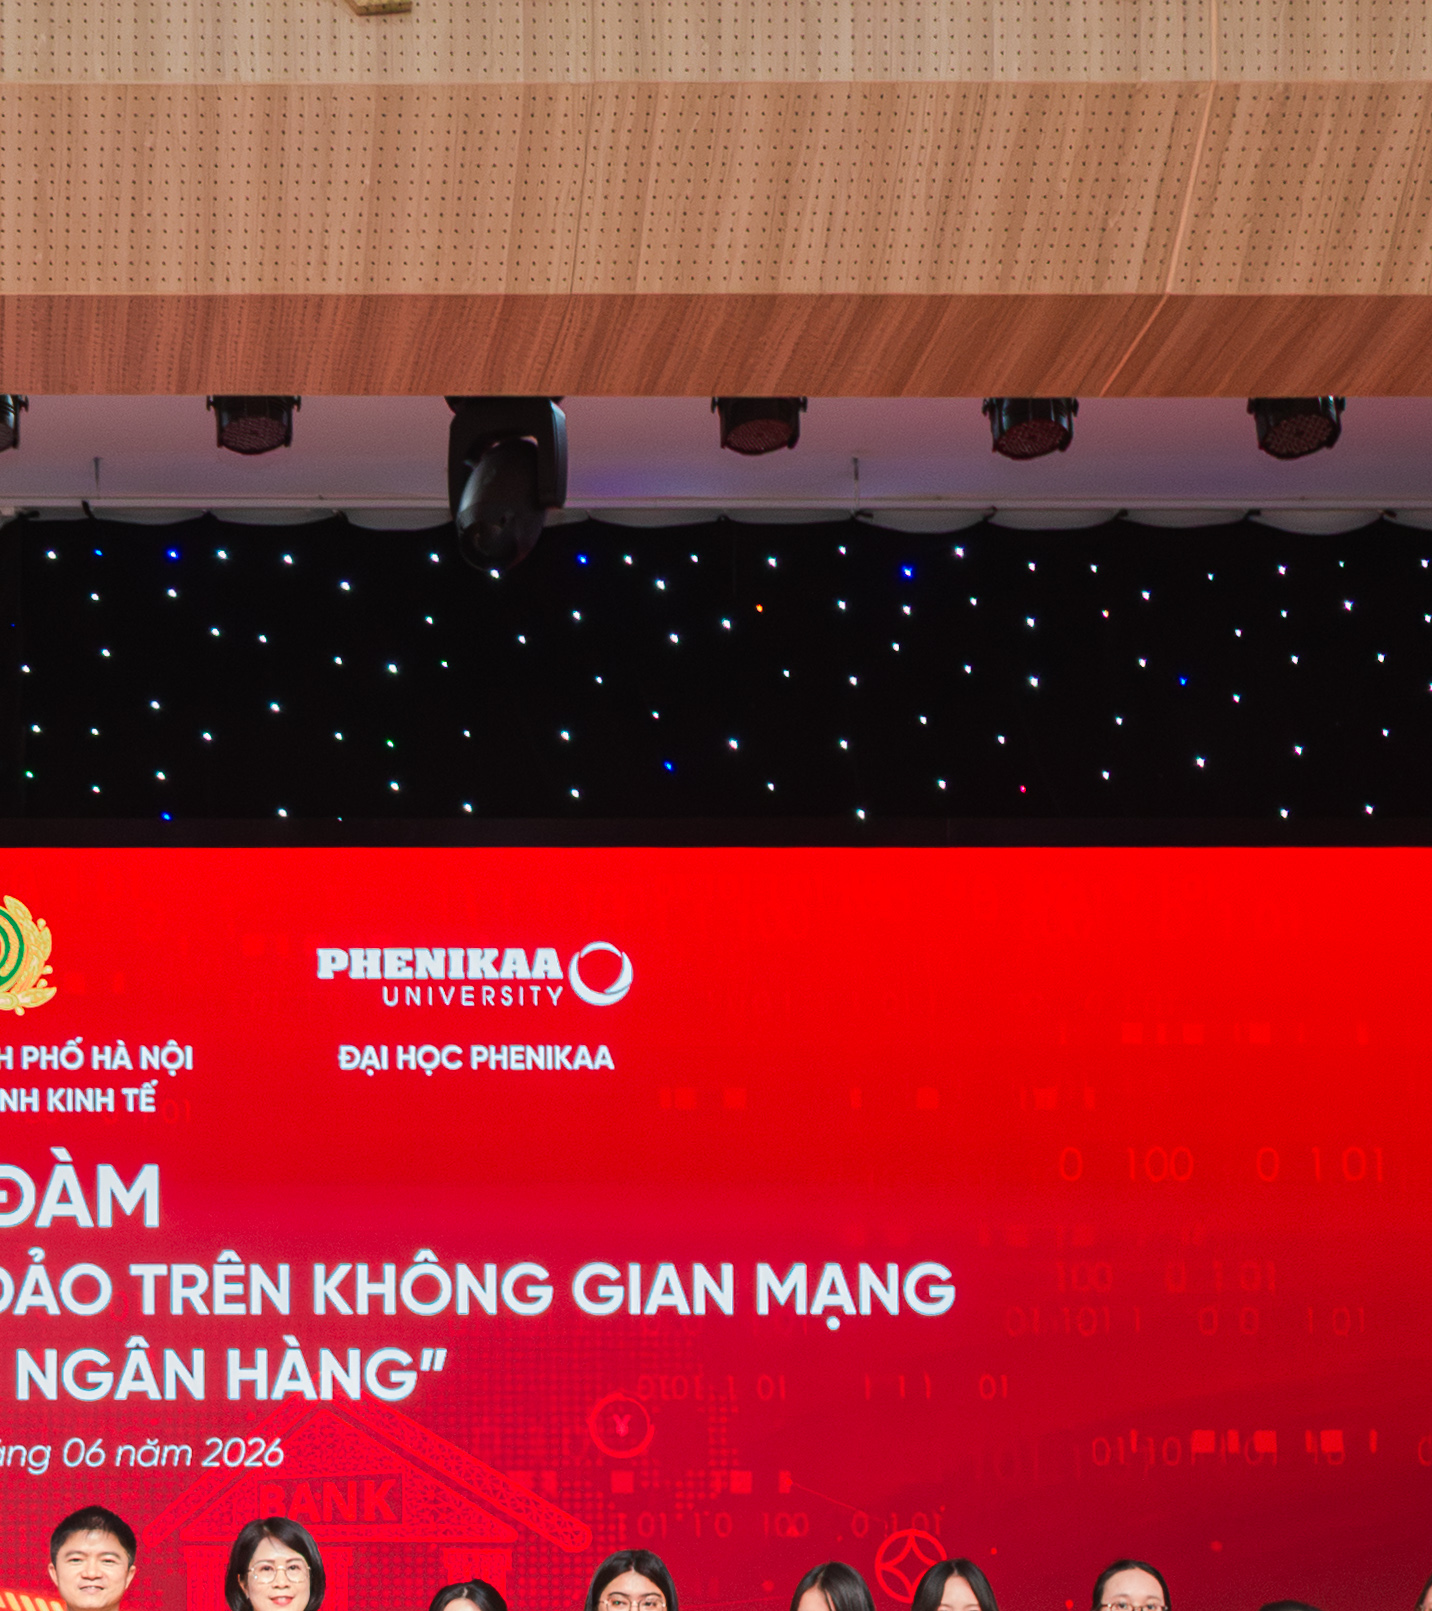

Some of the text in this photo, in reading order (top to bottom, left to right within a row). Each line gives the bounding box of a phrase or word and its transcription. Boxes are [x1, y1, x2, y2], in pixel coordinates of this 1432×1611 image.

[317, 948, 563, 979] PHENIKAA
[383, 986, 562, 1006] UNIVERSITY
[22, 1037, 84, 1070] PHỐ
[92, 1040, 133, 1070] HÀ
[140, 1040, 193, 1076] NỘI
[338, 1045, 614, 1076] ĐẠI HỌC PHENIKAA
[47, 1088, 114, 1112] KINH
[122, 1080, 158, 1112] TẾ
[129, 1250, 290, 1315] TRÊN
[314, 1249, 553, 1316] KHÔNG
[572, 1262, 733, 1315] GIAN
[757, 1262, 955, 1330] MẠNG
[16, 1335, 205, 1401] NGÂN
[227, 1335, 447, 1401] HÀNG”
[63, 1437, 105, 1467] 06
[115, 1439, 192, 1467] năm
[201, 1437, 284, 1467] 2026
[260, 1478, 399, 1523] BANK
